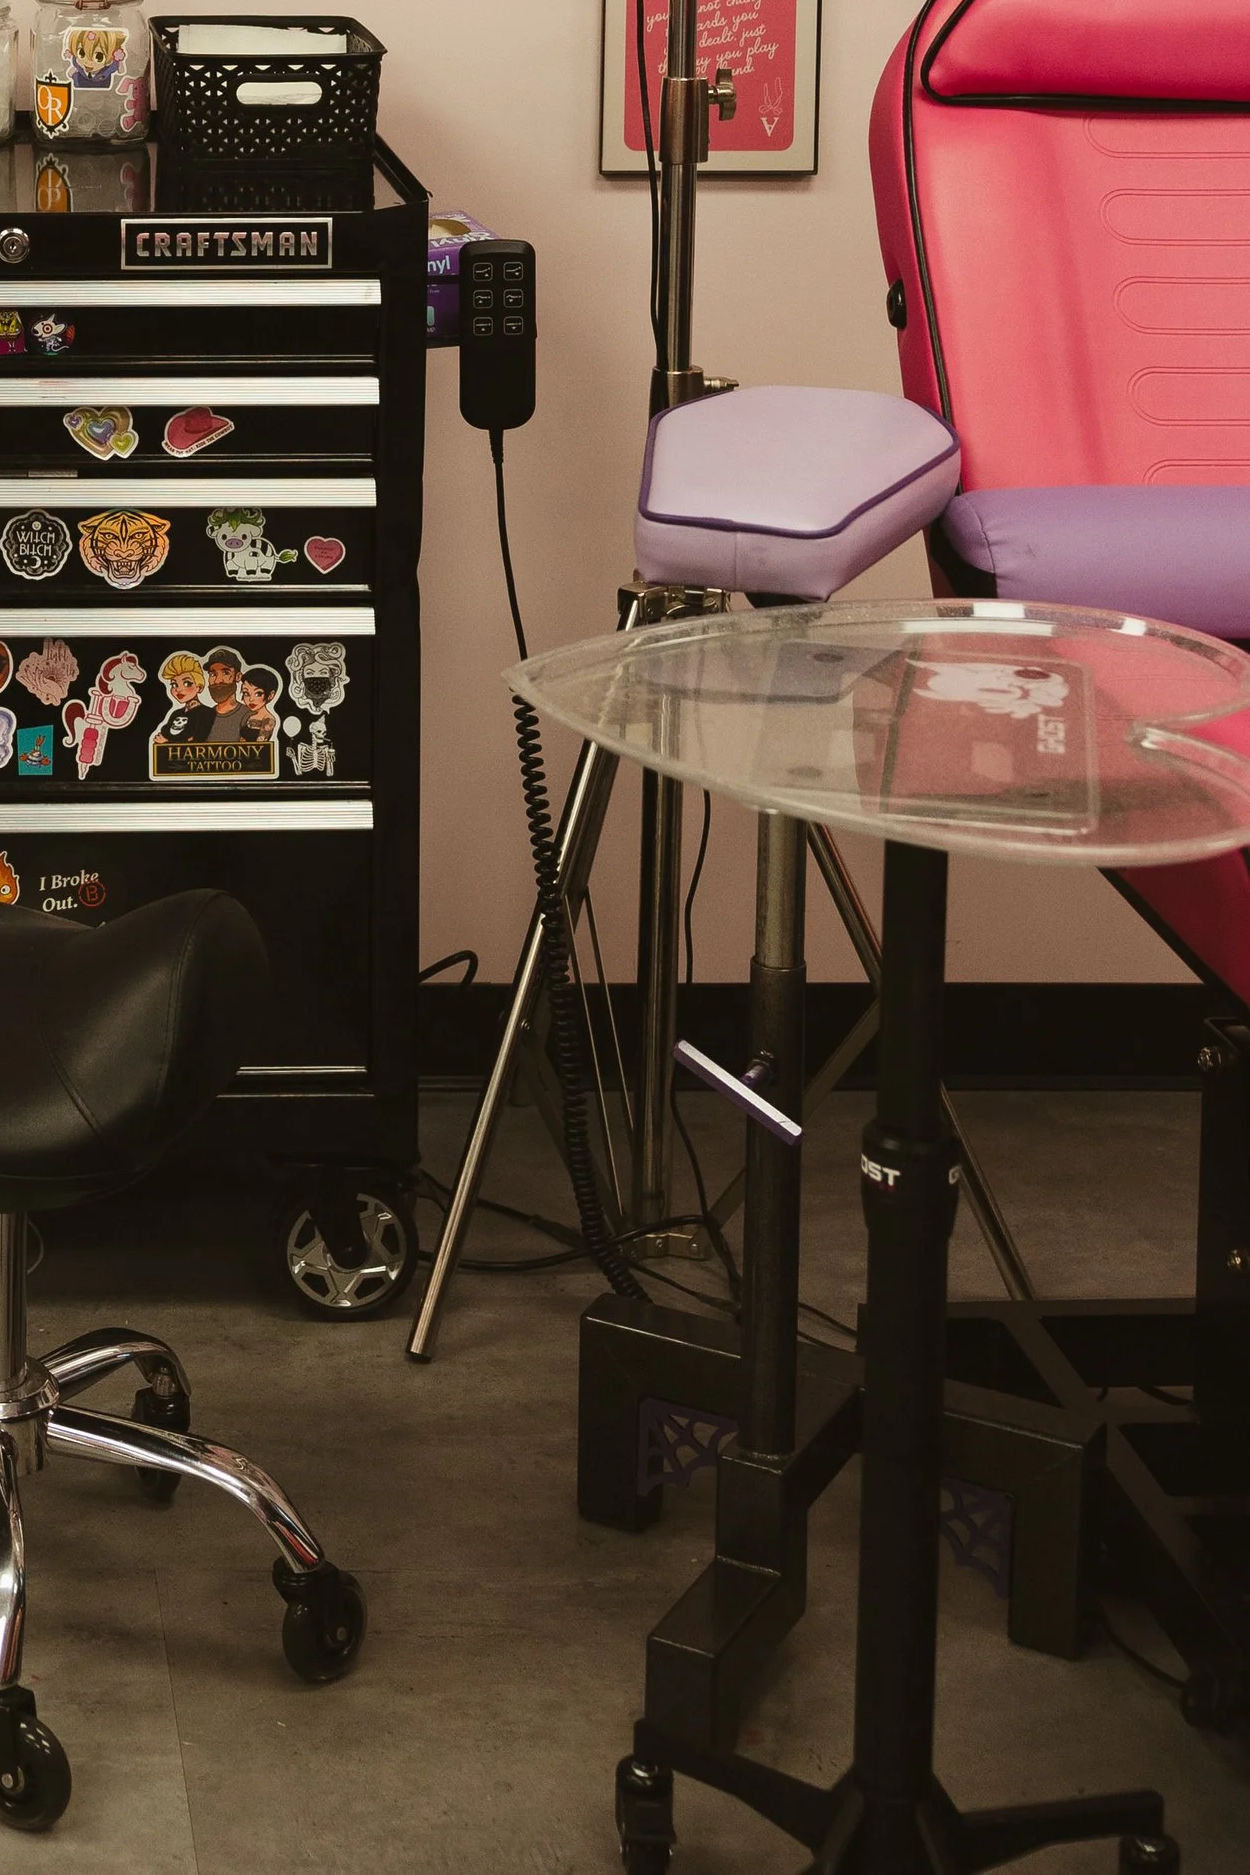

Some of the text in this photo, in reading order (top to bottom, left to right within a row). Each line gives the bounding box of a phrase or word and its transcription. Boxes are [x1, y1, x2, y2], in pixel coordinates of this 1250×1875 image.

[698, 0, 720, 14] not
[732, 11, 759, 28] you
[739, 24, 766, 47] just
[716, 37, 780, 63] you play
[136, 231, 318, 257] CRAFTSMAN
[16, 530, 56, 544] WITCH
[19, 543, 52, 556] BITCH
[167, 745, 265, 762] HARMONY
[187, 760, 242, 773] TATTOO
[39, 869, 99, 892] I Broke
[42, 895, 78, 912] Out.
